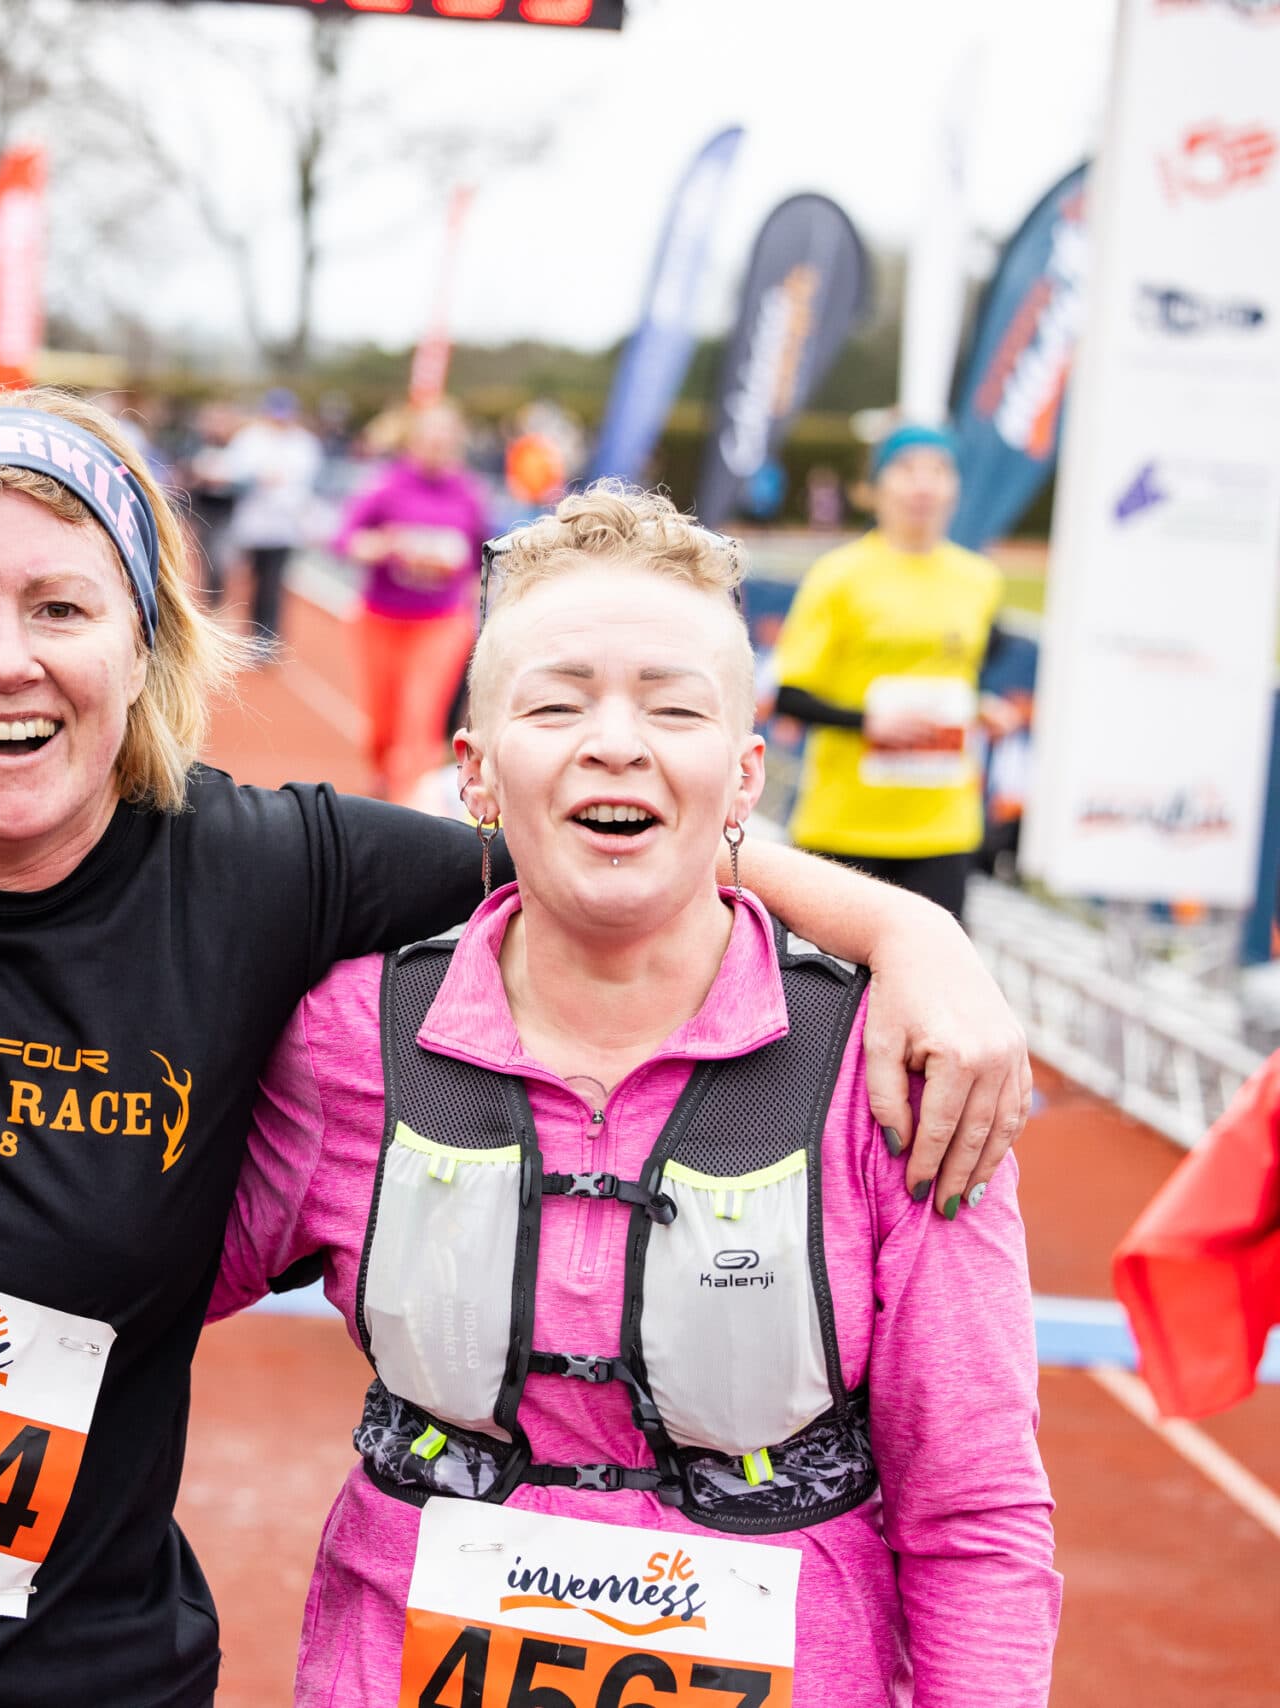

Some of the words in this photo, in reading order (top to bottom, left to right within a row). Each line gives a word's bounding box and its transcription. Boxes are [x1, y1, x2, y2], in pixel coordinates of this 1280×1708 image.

[6, 1080, 152, 1136] RACE
[700, 1271, 774, 1290] Kalenji
[507, 1556, 707, 1621] inverness
